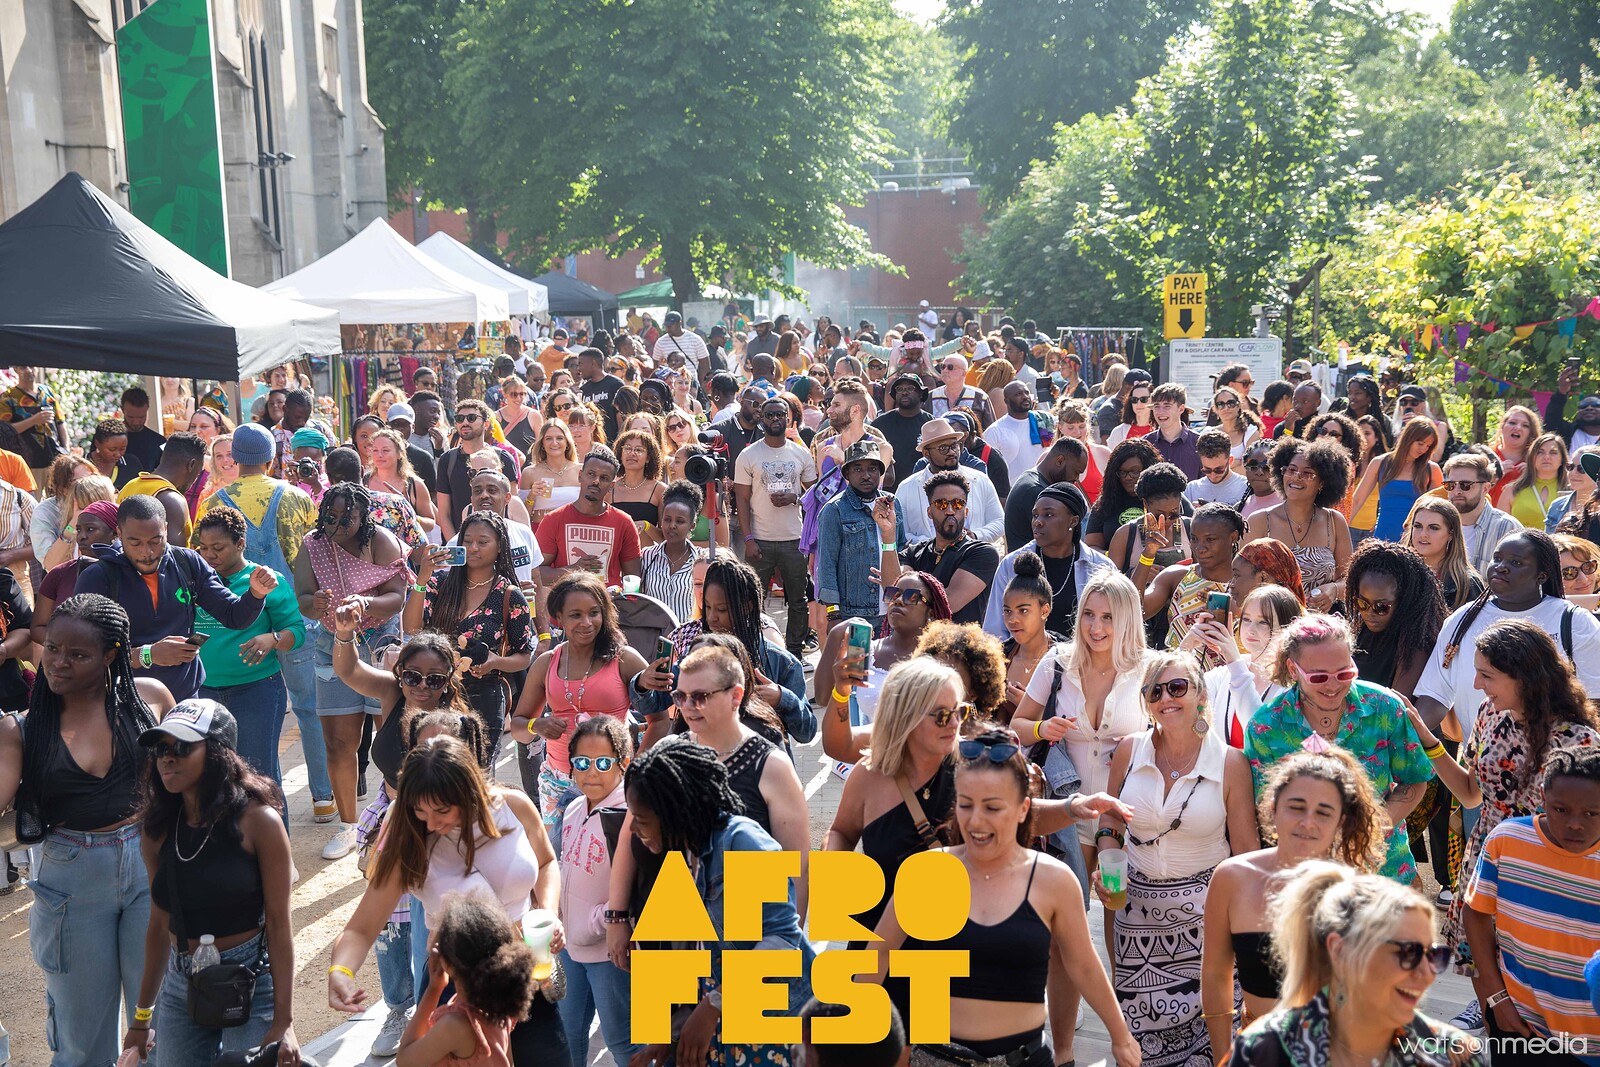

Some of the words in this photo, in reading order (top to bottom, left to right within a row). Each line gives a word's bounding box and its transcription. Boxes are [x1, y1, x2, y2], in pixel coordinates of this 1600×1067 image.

[1174, 277, 1197, 289] PAY
[1170, 292, 1202, 305] HERE
[570, 527, 610, 542] PUMA
